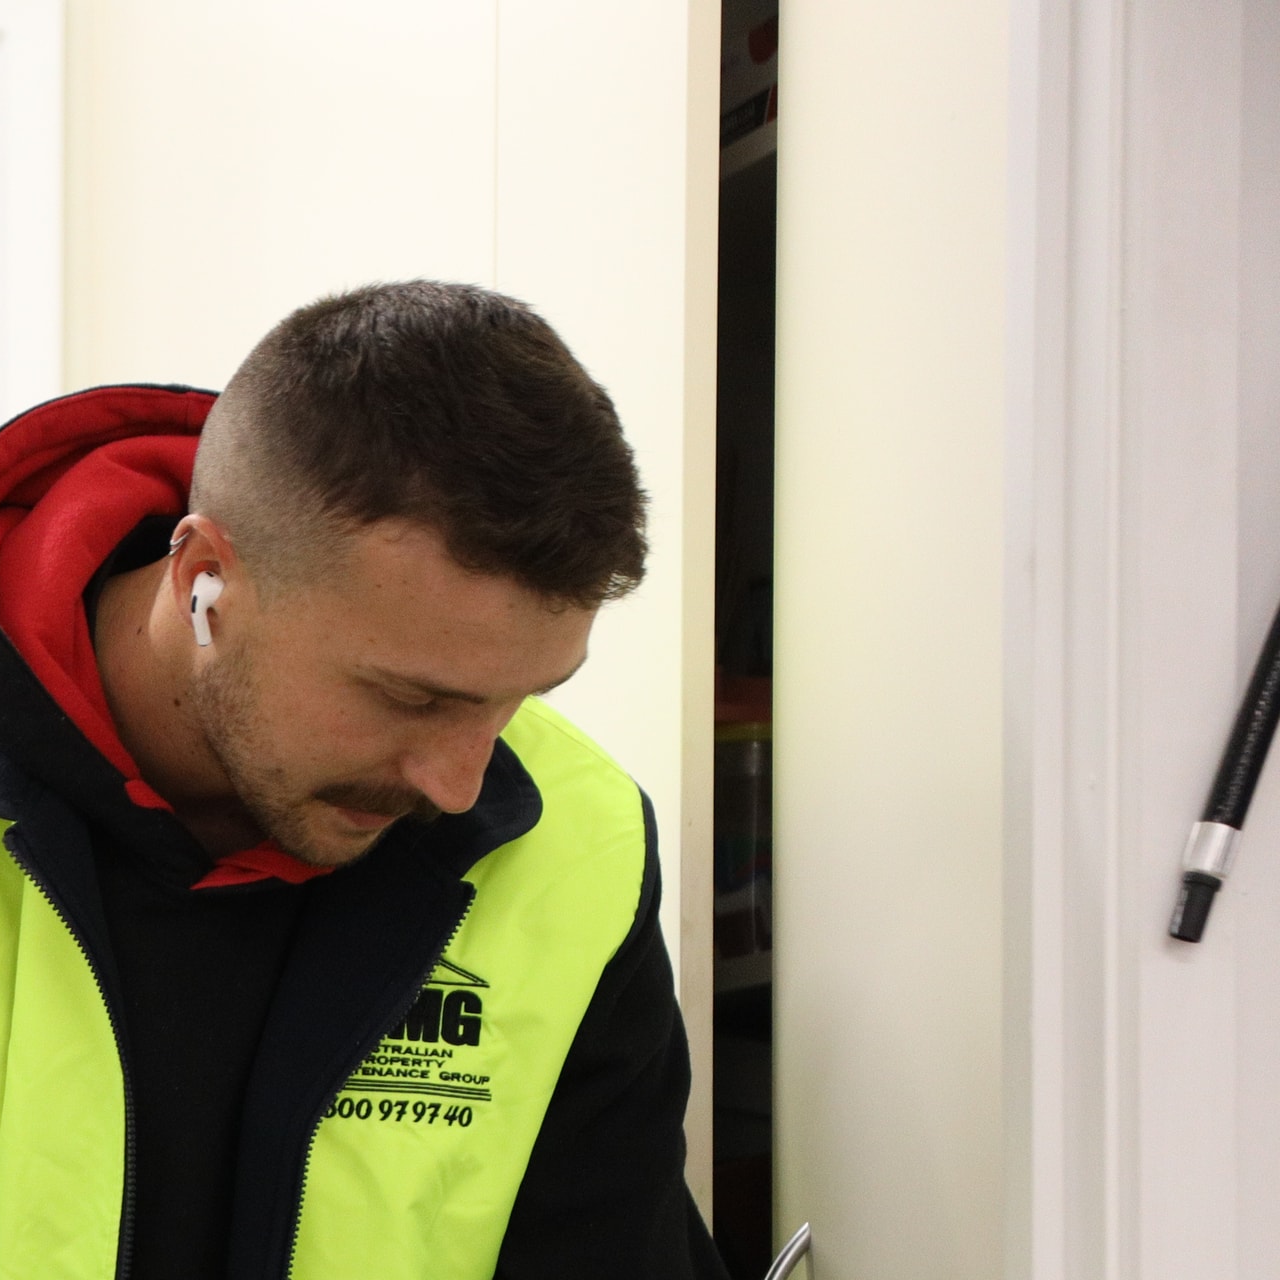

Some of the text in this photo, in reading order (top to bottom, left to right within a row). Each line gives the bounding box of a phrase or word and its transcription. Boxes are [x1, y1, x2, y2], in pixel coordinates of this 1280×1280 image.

[439, 1071, 490, 1085] GROUP
[378, 1099, 409, 1122] 97
[412, 1101, 441, 1124] 97
[443, 1105, 473, 1127] 40
